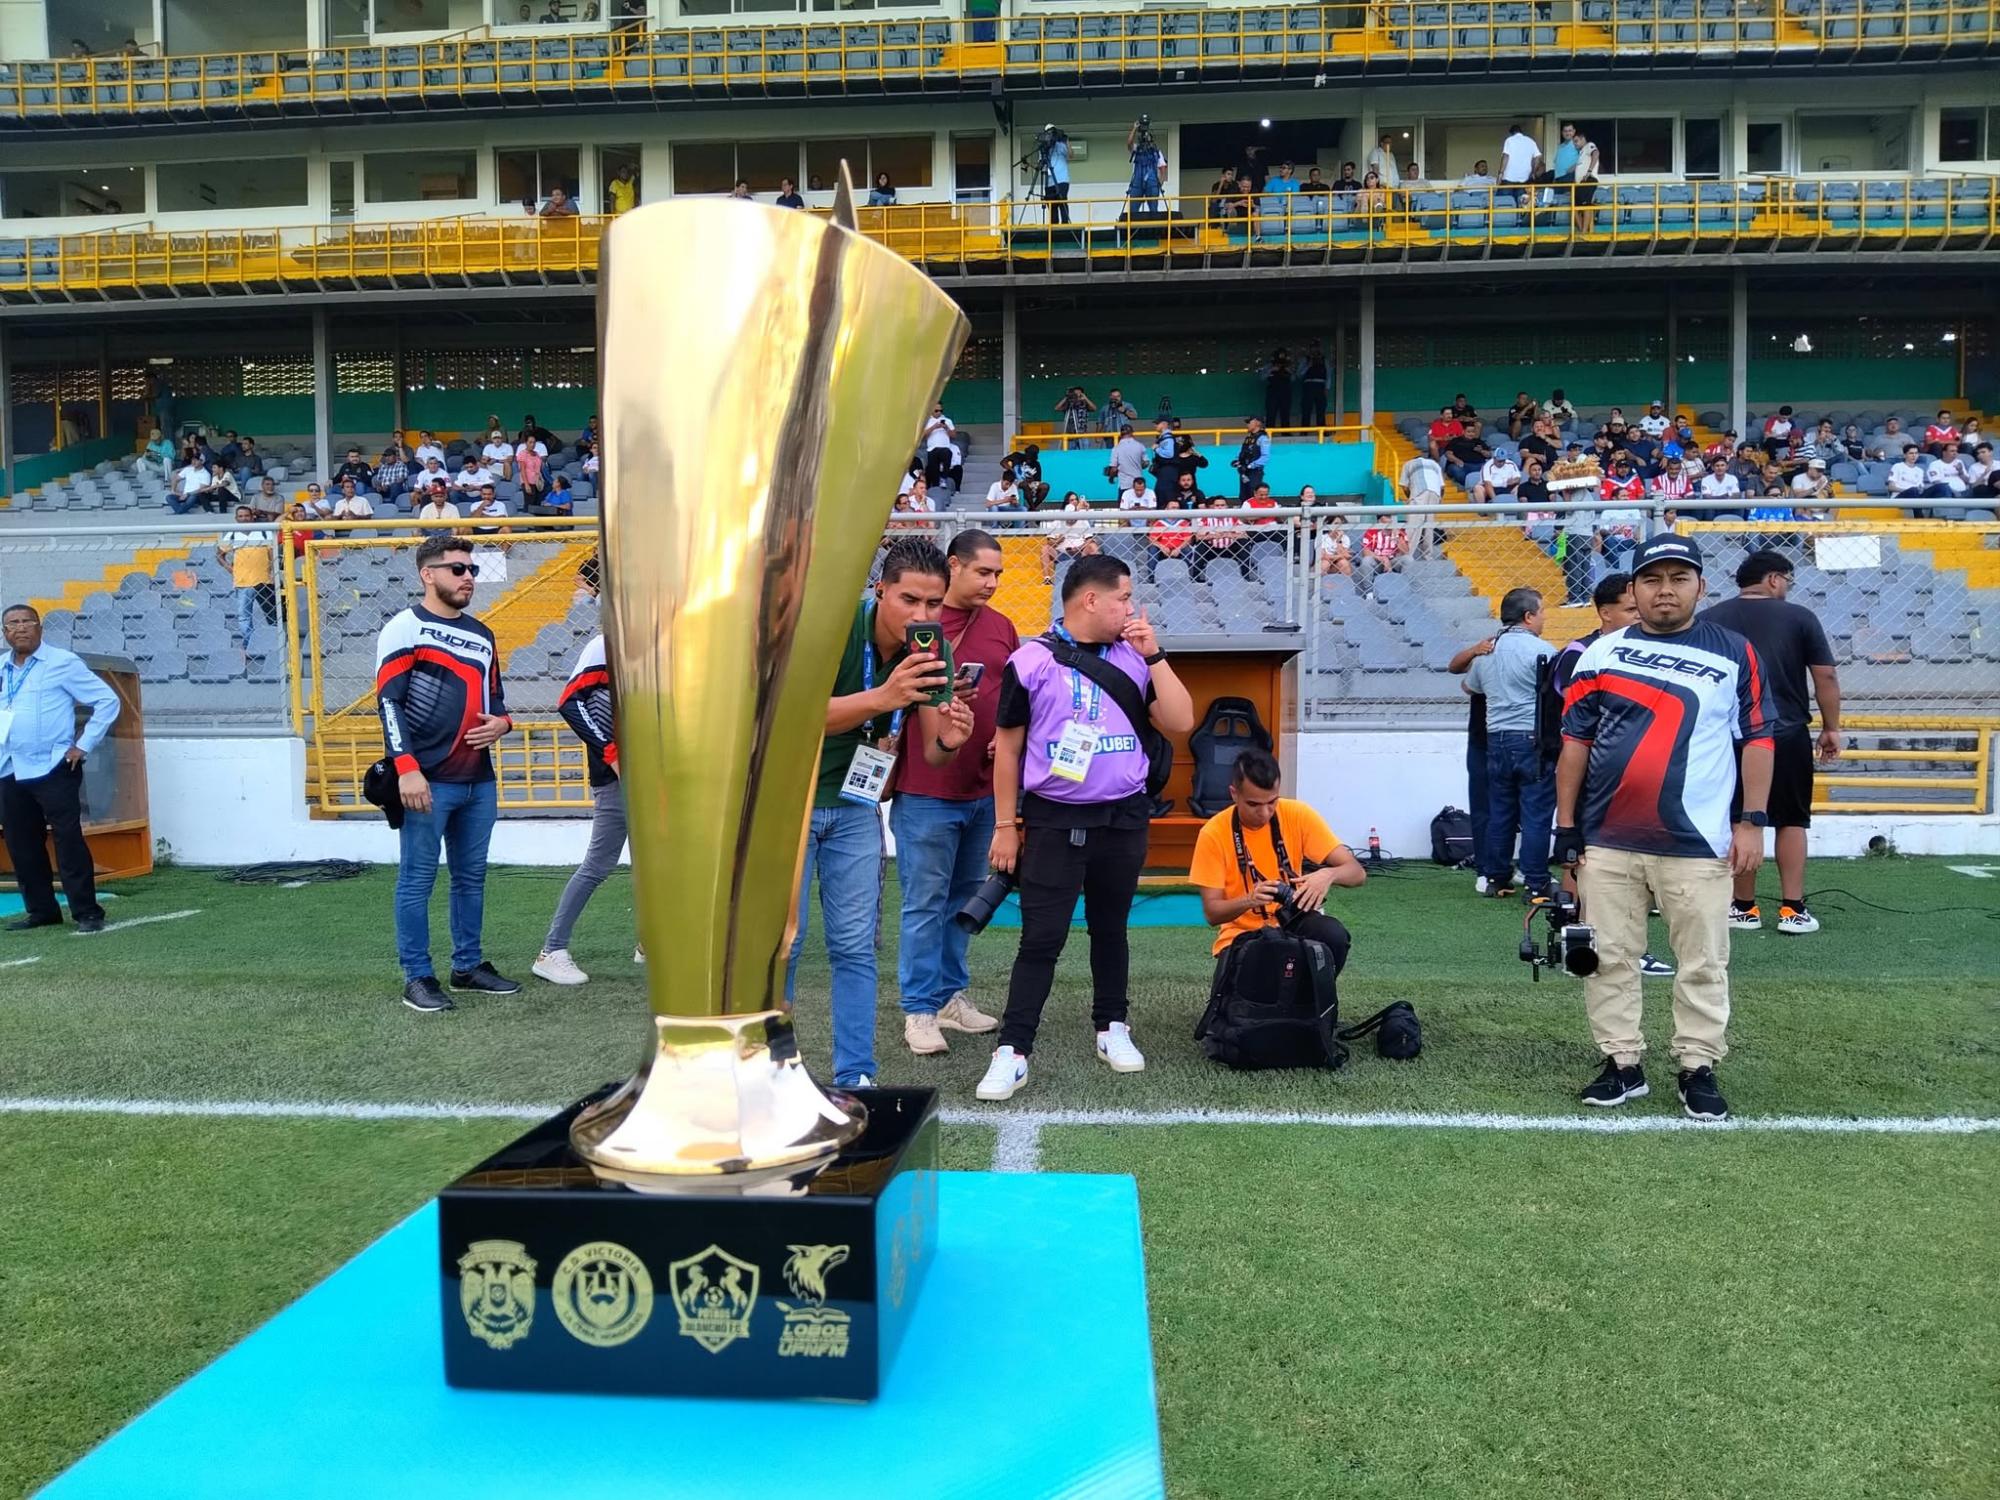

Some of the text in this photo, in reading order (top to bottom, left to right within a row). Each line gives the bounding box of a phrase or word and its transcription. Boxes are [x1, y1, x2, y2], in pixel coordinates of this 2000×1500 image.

[420, 627, 492, 657] RYDER
[1607, 646, 1729, 684] RYDER
[1049, 736, 1135, 758] HDUBET
[783, 1323, 849, 1337] LOBOS
